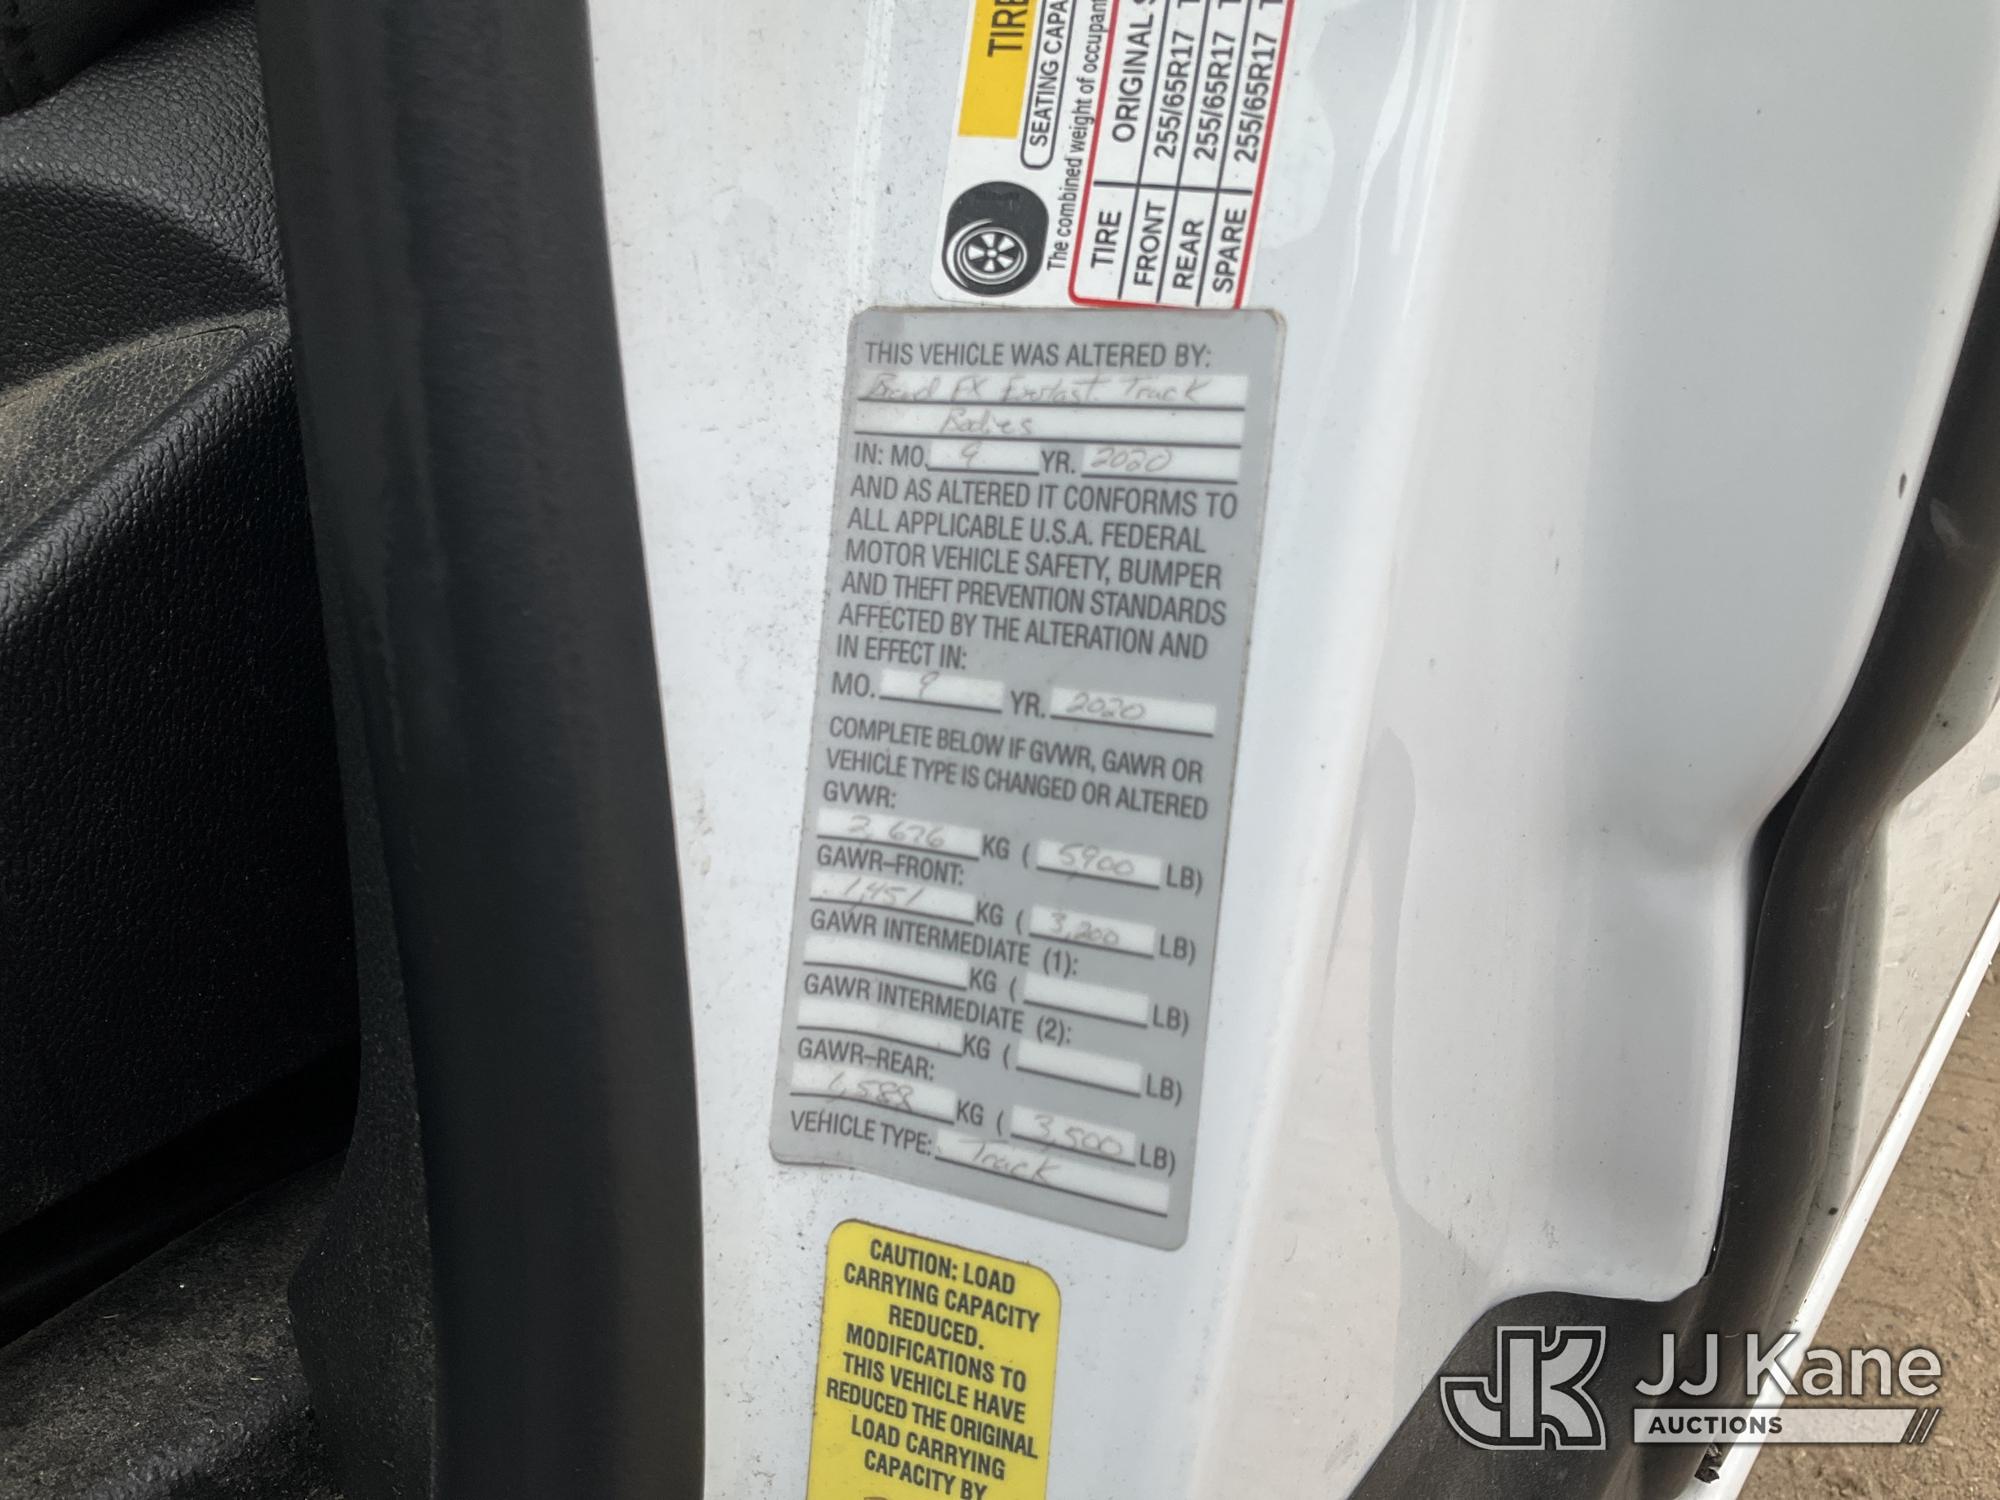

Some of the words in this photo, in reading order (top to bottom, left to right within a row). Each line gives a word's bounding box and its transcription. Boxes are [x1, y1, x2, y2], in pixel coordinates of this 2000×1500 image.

[1083, 0, 1109, 74] occupan
[1030, 59, 1060, 148] SEATING
[1079, 77, 1095, 94] of
[1068, 96, 1095, 158] weight
[1091, 209, 1123, 269] TIRE
[1111, 14, 1154, 144] ORIGINAL
[1133, 201, 1167, 287] FRONT
[1153, 30, 1195, 159] 255/65R17
[1172, 218, 1205, 290] REAR
[1193, 31, 1236, 162] 255/65R17
[1212, 208, 1247, 294] SPARE
[1233, 32, 1278, 163] 255/65R17
[1056, 157, 1083, 238] combined
[1047, 241, 1067, 271] The
[865, 341, 913, 366] THIS
[919, 342, 1004, 367] VEHICLE
[1011, 343, 1060, 367] WAS
[1065, 343, 1167, 368] ALTERED
[1174, 344, 1212, 369] BY:
[854, 442, 884, 466] IN:
[890, 445, 929, 469] MO.
[1041, 450, 1077, 475] YR.
[1090, 447, 1173, 472] 2020
[847, 506, 890, 532] ALL
[895, 510, 1023, 541] APPLICABLE
[1030, 517, 1094, 547] U.S.A.
[1101, 523, 1207, 553] FEDERAL
[850, 474, 898, 500] AND
[903, 476, 933, 501] AS
[937, 478, 1030, 509] ALTERED
[1037, 484, 1055, 509] IT
[1063, 486, 1197, 518] CONFORMS
[1205, 492, 1238, 519] TO
[845, 539, 926, 568] MOTOR
[932, 544, 1019, 575] VEHICLE
[1024, 550, 1111, 586] SAFETY,
[1118, 557, 1222, 590] BUMPER
[838, 602, 944, 635] AFFECTED
[950, 611, 979, 638] BY
[983, 615, 1020, 642] THE
[1024, 618, 1155, 656] ALTERATION
[1159, 630, 1208, 660] AND
[841, 571, 888, 596] AND
[893, 574, 953, 601] THEFT
[957, 580, 1085, 614] PREVENTION
[1090, 590, 1227, 625] STANDARDS
[836, 633, 859, 659] IN
[864, 637, 937, 667] EFFECT
[939, 645, 967, 670] IN:
[831, 671, 876, 699] MO.
[1010, 691, 1047, 719] YR.
[1067, 692, 1147, 721] 2020
[829, 715, 933, 749] COMPLETE
[937, 726, 1005, 758] BELOW
[1009, 736, 1027, 760] IF
[1029, 738, 1097, 773] GVWR,
[1102, 747, 1166, 780] GAWR
[1171, 756, 1203, 784] OR
[823, 779, 897, 809] GVWR:
[827, 747, 908, 780] VEHICLE
[911, 757, 958, 788] TYPE
[961, 765, 980, 789] IS
[984, 766, 1077, 802] CHANGED
[1081, 779, 1112, 807] OR
[1115, 783, 1209, 820] ALTERED
[982, 834, 1010, 861] KG
[1165, 863, 1204, 896] LB)
[810, 908, 878, 939] GAWR
[883, 917, 1031, 967] INTERMEDIATE
[1042, 948, 1079, 978] (1):
[975, 900, 1005, 927] KG
[1159, 934, 1197, 966] LB)
[803, 972, 872, 1001] GAWR
[876, 981, 1025, 1034] INTERMEDIATE
[1035, 1014, 1072, 1047] (2):
[968, 965, 998, 993] KG
[1152, 1003, 1190, 1036] LB)
[962, 1033, 991, 1061] KG
[1146, 1073, 1184, 1107] LB)
[790, 1109, 876, 1142] VEHICLE
[880, 1122, 934, 1157] TYPE:
[955, 1100, 985, 1127] KG
[1140, 1142, 1177, 1175] LB)
[843, 1262, 940, 1307] CARRYING
[944, 1288, 1041, 1334] CAPACITY
[869, 1238, 959, 1282] CAUTION:
[963, 1261, 1016, 1296] LOAD
[846, 1322, 995, 1384] MODIFICATIONS
[999, 1365, 1027, 1393] TO
[888, 1304, 985, 1350] REDUCED.
[826, 1377, 908, 1420] REDUCED
[911, 1401, 947, 1432] THE
[950, 1415, 1040, 1460] ORIGINAL
[842, 1351, 885, 1383] THIS
[889, 1364, 969, 1408] VEHICLE
[972, 1389, 1027, 1425] HAVE
[850, 1414, 901, 1448] LOAD
[905, 1432, 1006, 1481] CARRYING
[863, 1449, 957, 1496] CAPACITY
[960, 1477, 988, 1500] BY
